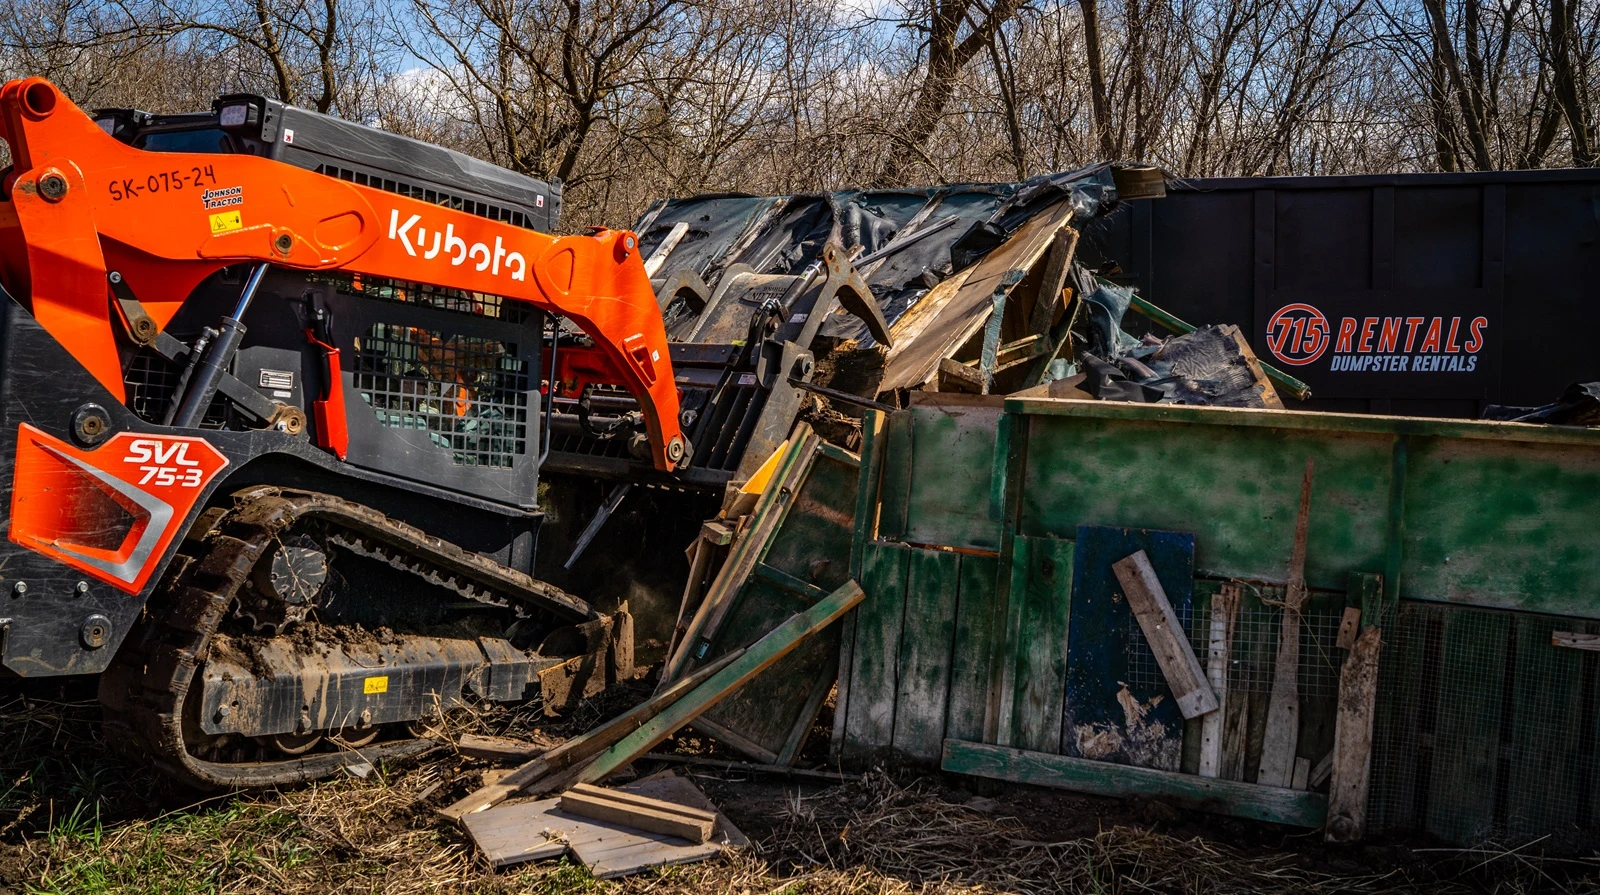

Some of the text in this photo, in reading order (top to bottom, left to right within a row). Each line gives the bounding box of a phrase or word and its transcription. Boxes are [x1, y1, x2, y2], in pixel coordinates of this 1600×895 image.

[109, 164, 216, 201] SK-075-24
[388, 208, 526, 282] Kubota
[1273, 316, 1488, 354] 715 RENTALS
[1330, 355, 1478, 372] DUMPSTER RENTALS
[123, 439, 199, 466] SVL
[138, 466, 203, 487] 75-3
